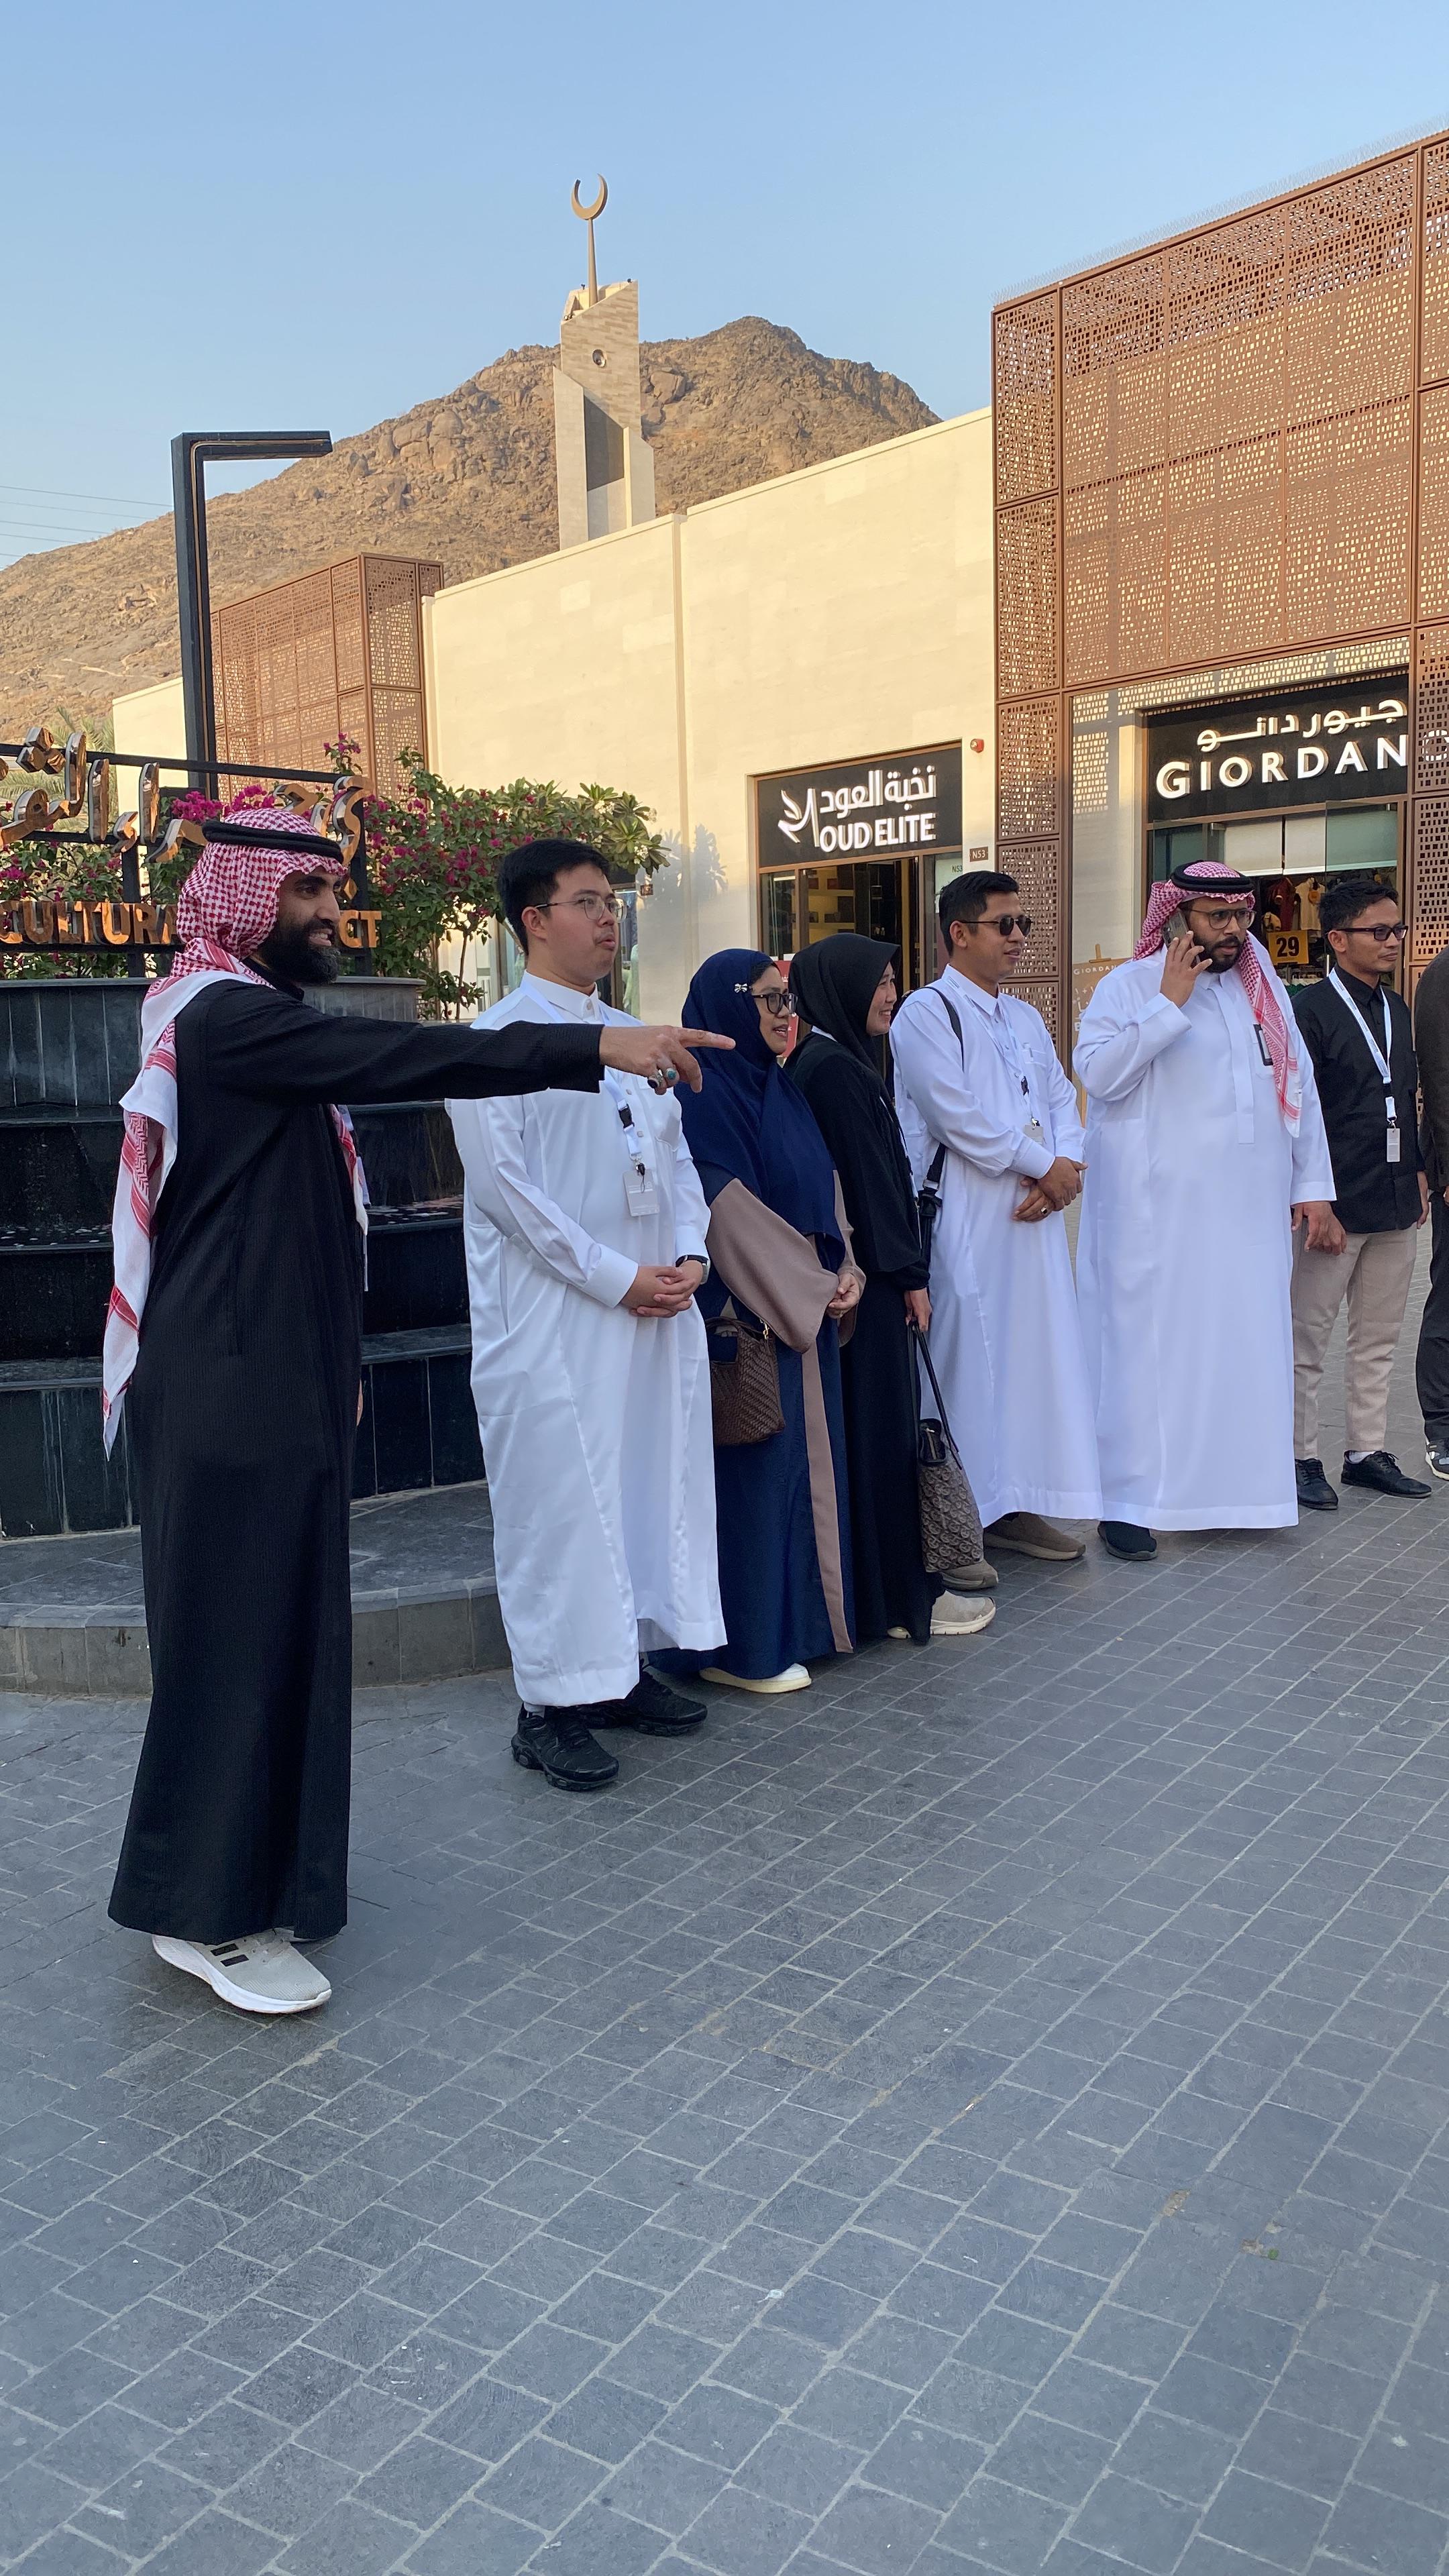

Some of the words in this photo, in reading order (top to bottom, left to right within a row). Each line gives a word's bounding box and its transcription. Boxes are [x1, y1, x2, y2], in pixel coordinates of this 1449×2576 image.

[820, 769, 883, 819] العود
[884, 765, 937, 811] نخبة
[819, 822, 873, 853] OUD
[875, 812, 936, 847] ELITE
[972, 849, 986, 859] N53
[0, 900, 179, 945] CULTURA
[1276, 936, 1299, 957] 29
[1073, 965, 1117, 975] GIORDAN
